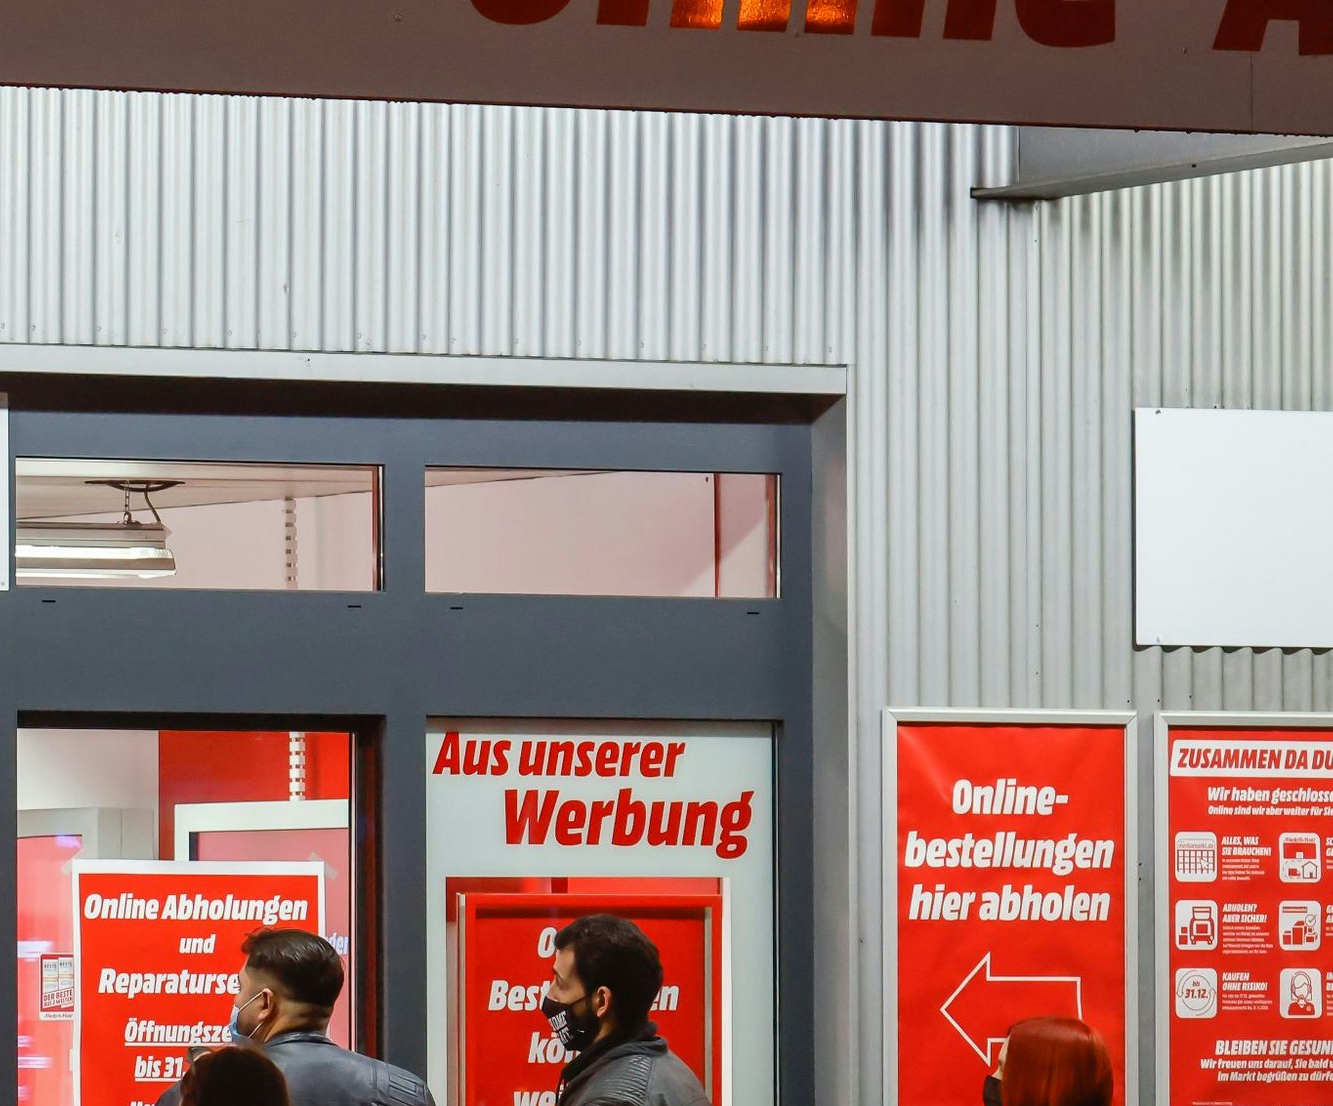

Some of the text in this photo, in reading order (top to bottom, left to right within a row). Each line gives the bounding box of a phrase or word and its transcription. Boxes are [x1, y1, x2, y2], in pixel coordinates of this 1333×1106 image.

[432, 731, 685, 779] Aus unserer
[1177, 748, 1282, 769] ZUSAMMEN
[1284, 749, 1308, 770] DA
[952, 777, 1070, 816] Online-
[1207, 787, 1230, 801] Wir
[1231, 787, 1270, 802] haben
[1207, 805, 1233, 815] Online
[1234, 805, 1251, 815] sind
[1252, 806, 1265, 815] wir
[1265, 806, 1283, 816] aber
[1284, 806, 1309, 816] weiter
[1310, 806, 1323, 816] für
[502, 786, 754, 859] Werbung
[904, 830, 1116, 876] bestellungen
[83, 893, 308, 926] Online Abholungen
[908, 883, 1111, 921] hier abholen
[179, 933, 216, 954] und
[1214, 1039, 1333, 1056] BLEIBEN SIE GESUN
[134, 1055, 161, 1078] bis
[1200, 1058, 1328, 1070] Wir freuen uns darauf, Sie bald
[1229, 1071, 1255, 1082] Markt
[1256, 1071, 1297, 1083] begrüßen
[1298, 1073, 1309, 1082] zu
